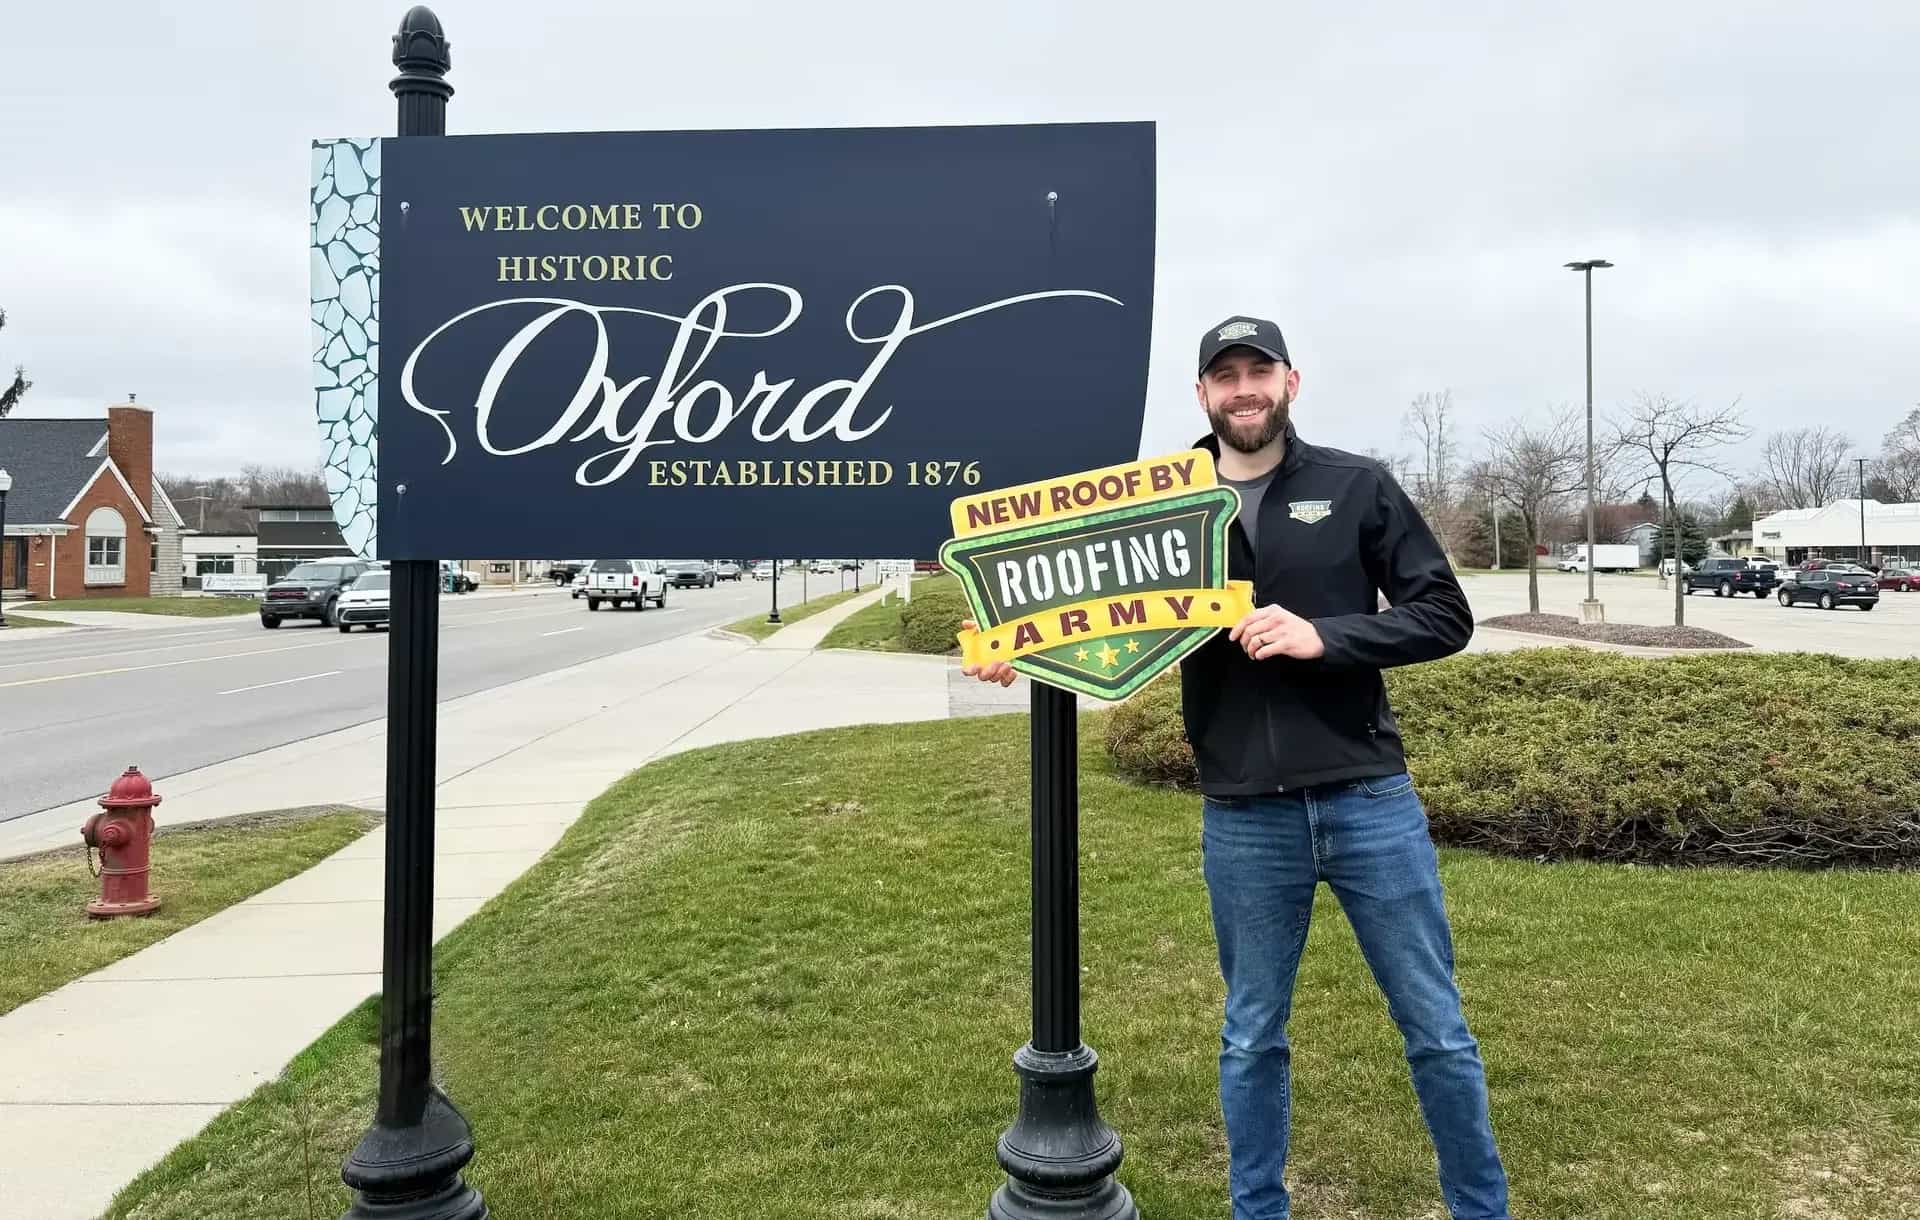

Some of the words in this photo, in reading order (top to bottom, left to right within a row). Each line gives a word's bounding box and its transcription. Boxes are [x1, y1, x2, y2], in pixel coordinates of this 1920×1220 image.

[458, 205, 643, 231] WELCOME
[653, 203, 702, 230] TO
[496, 255, 673, 281] HISTORIC
[401, 283, 1124, 487] Oxford
[648, 461, 894, 486] ESTABLISHED
[907, 461, 981, 486] 1876
[967, 490, 1041, 529] NEW
[1051, 471, 1141, 512] ROOF
[1150, 458, 1195, 488] BY
[996, 528, 1192, 608] ROOFING
[1013, 595, 1194, 650] ARMY
